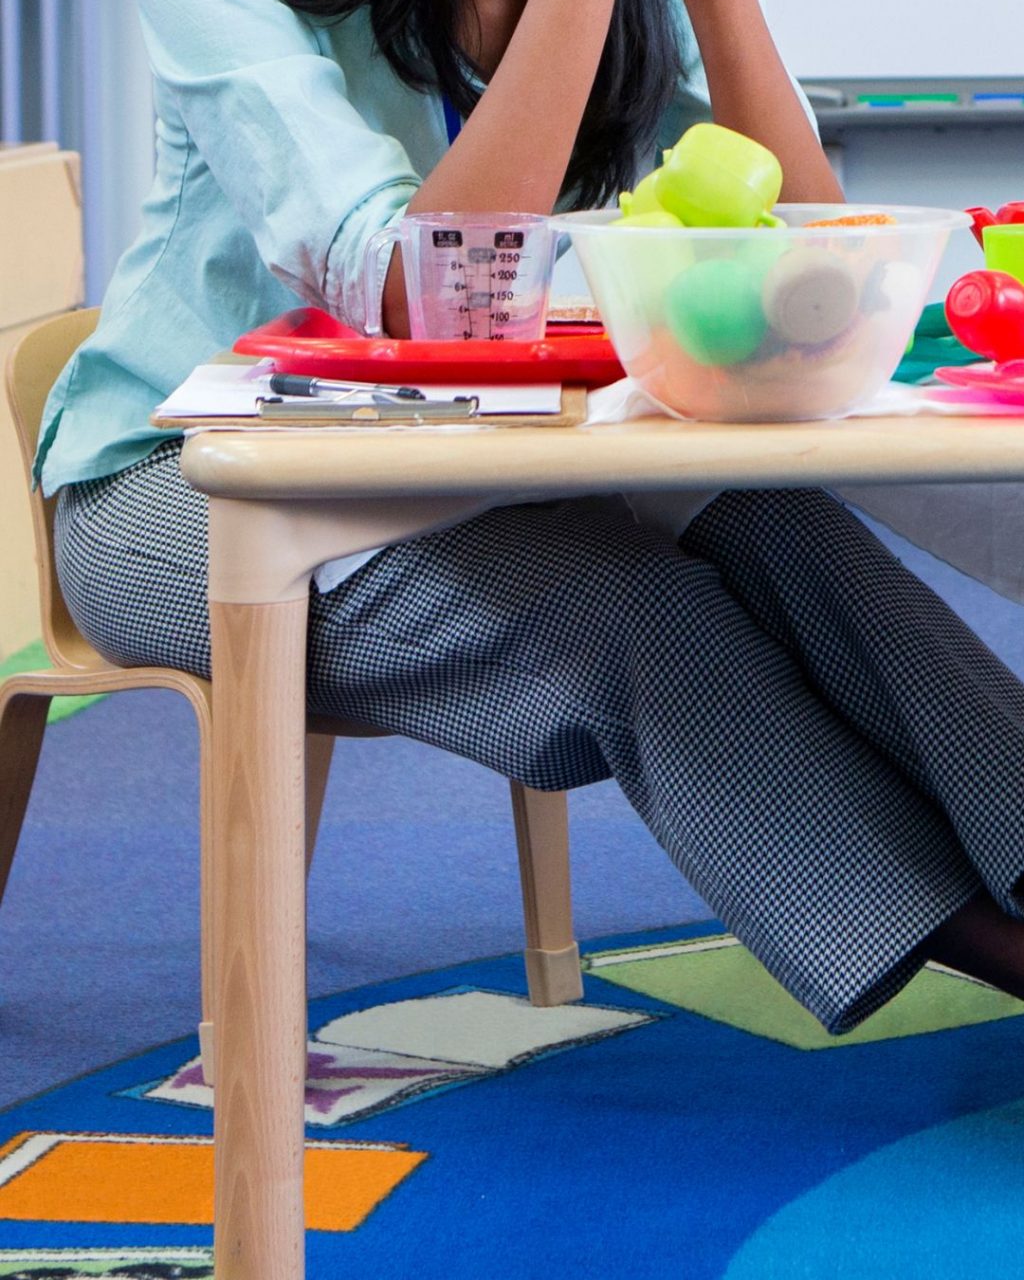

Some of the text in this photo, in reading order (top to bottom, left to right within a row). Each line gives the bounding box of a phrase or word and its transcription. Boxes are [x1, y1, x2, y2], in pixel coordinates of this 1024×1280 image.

[499, 253, 520, 263] 250
[451, 261, 457, 271] 8
[498, 270, 517, 280] 200
[454, 282, 460, 292] 6
[497, 291, 514, 301] 150
[495, 312, 510, 322] 100
